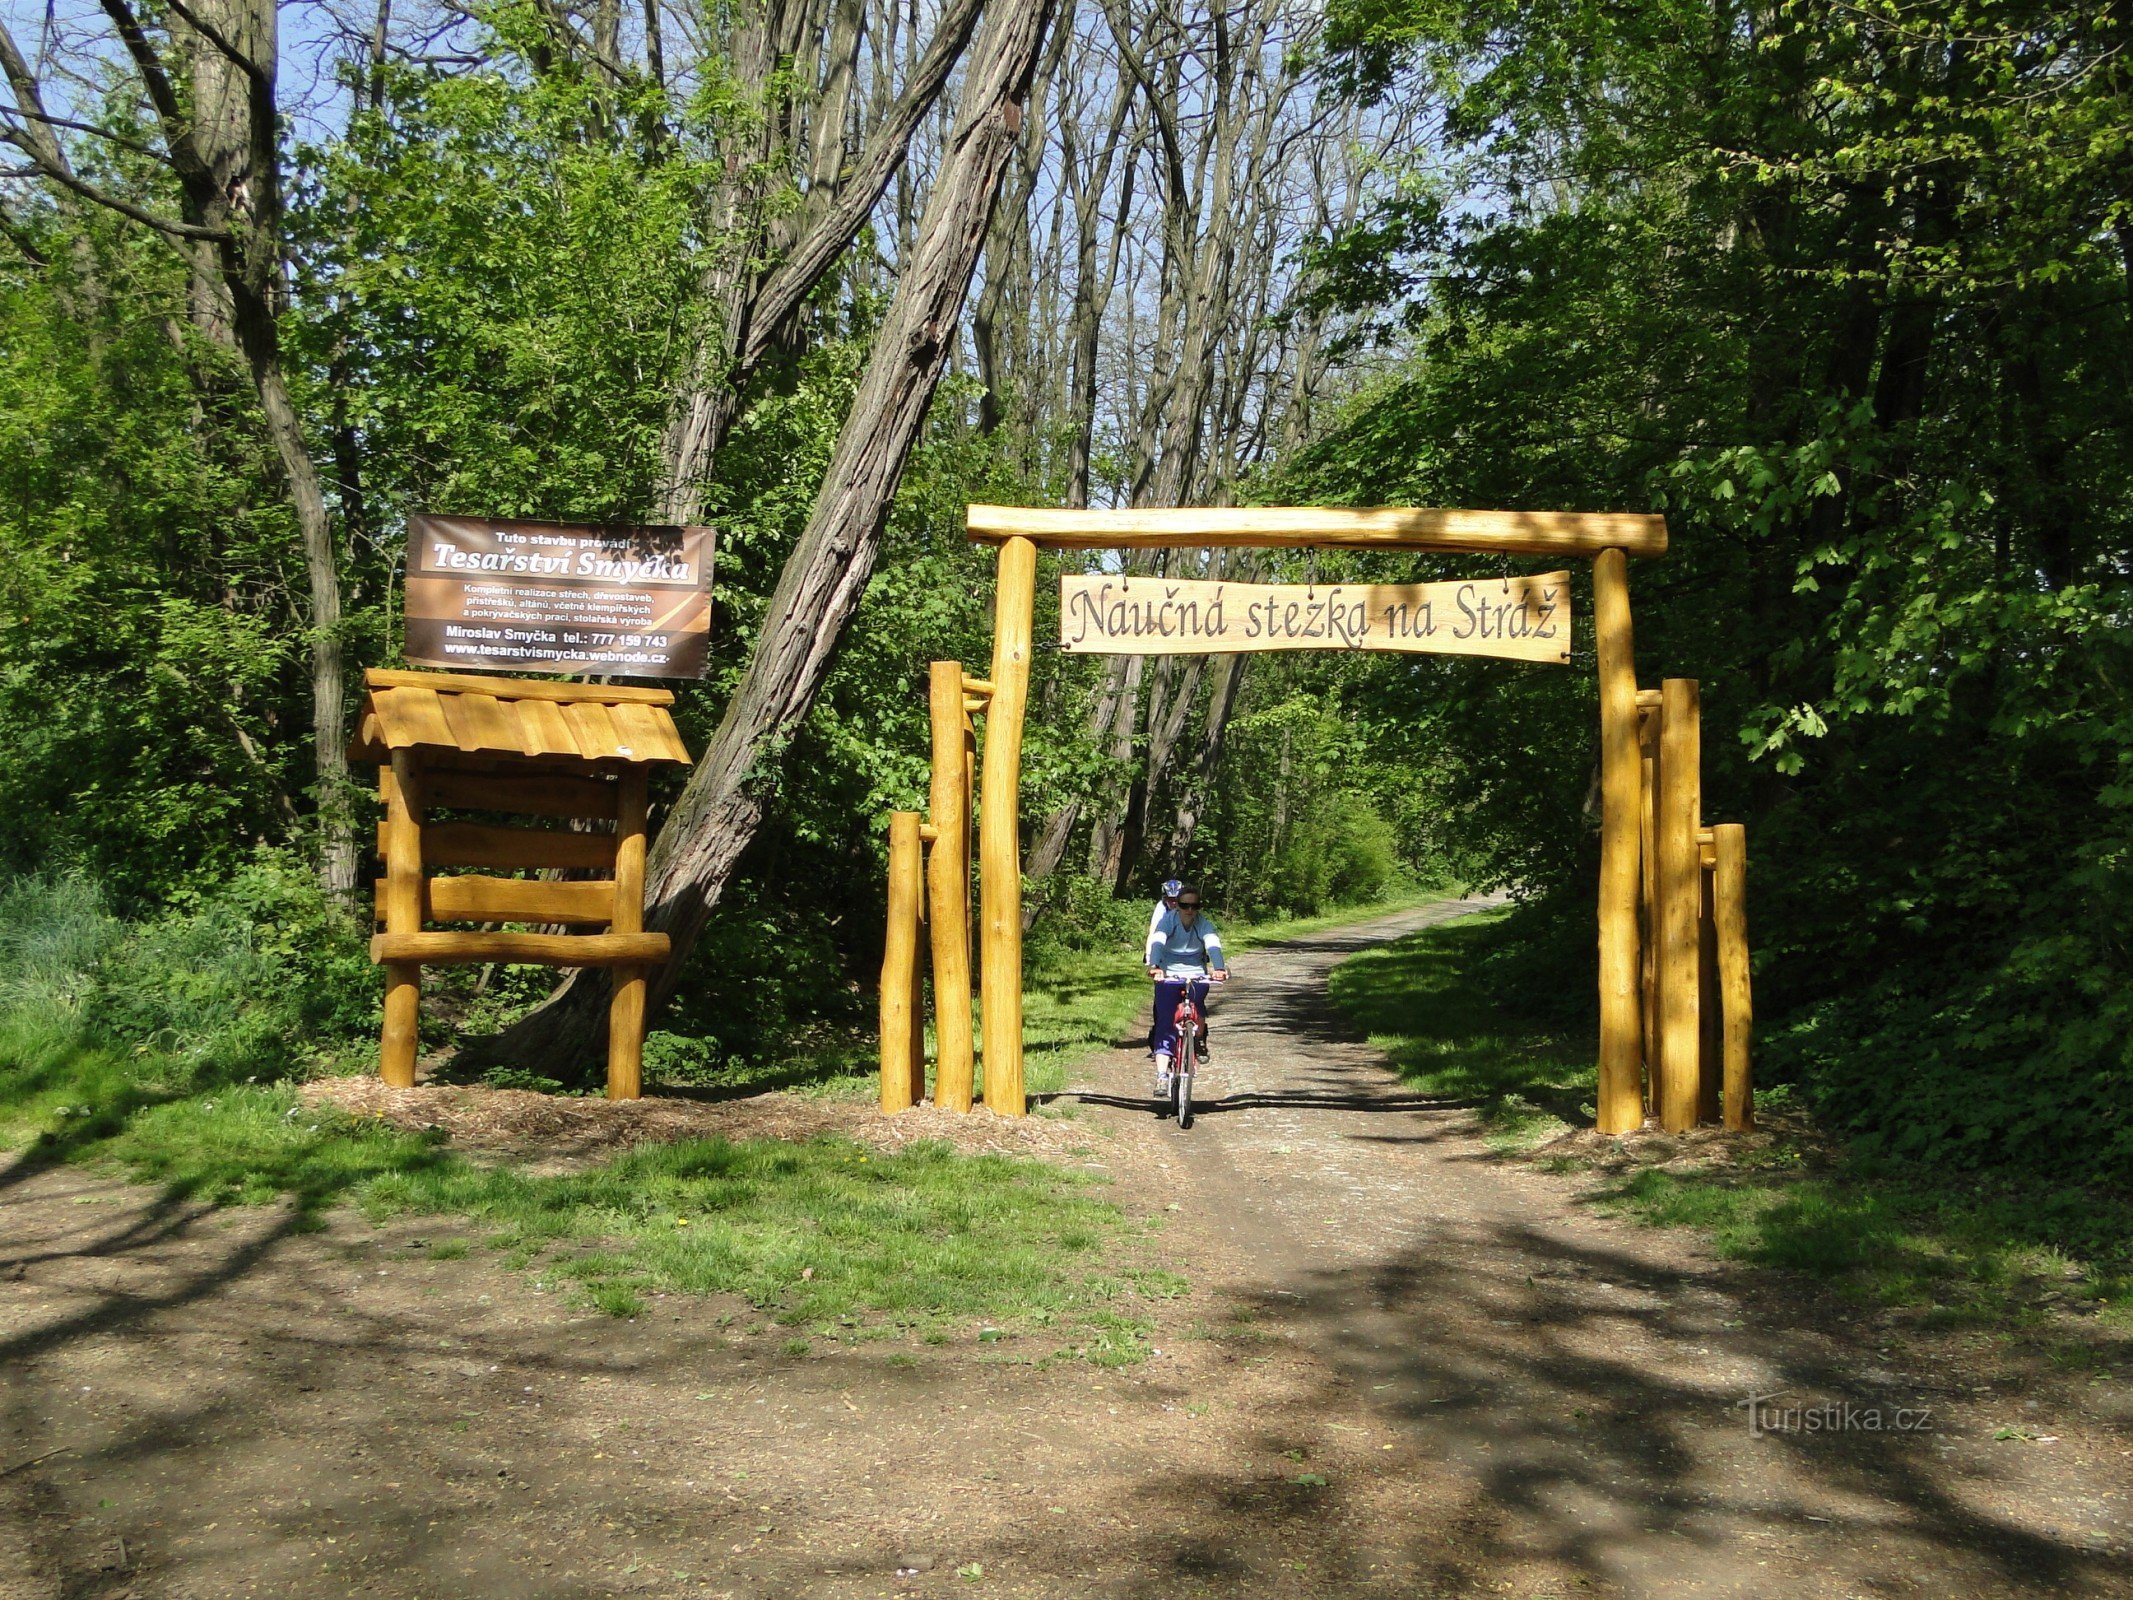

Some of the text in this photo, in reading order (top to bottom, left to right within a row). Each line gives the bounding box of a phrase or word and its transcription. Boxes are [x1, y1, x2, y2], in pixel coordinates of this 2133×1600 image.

[495, 532, 630, 550] Tuto stavbu provádí
[433, 543, 690, 585] Tesařství Smyčka
[463, 584, 655, 603] Kompletní realizace střech, dřevostaveb,
[463, 609, 470, 617] a
[471, 608, 543, 622] pokrývačských
[619, 616, 653, 627] výroba
[554, 601, 585, 611] včetně
[587, 603, 651, 616] klempířských
[1070, 583, 1558, 648] Naučná stezka na Stráž
[445, 625, 668, 648] Miroslav Smyčka tel.: 777 159 743
[444, 643, 667, 664] www.tesarstvismycka.webnode.cz
